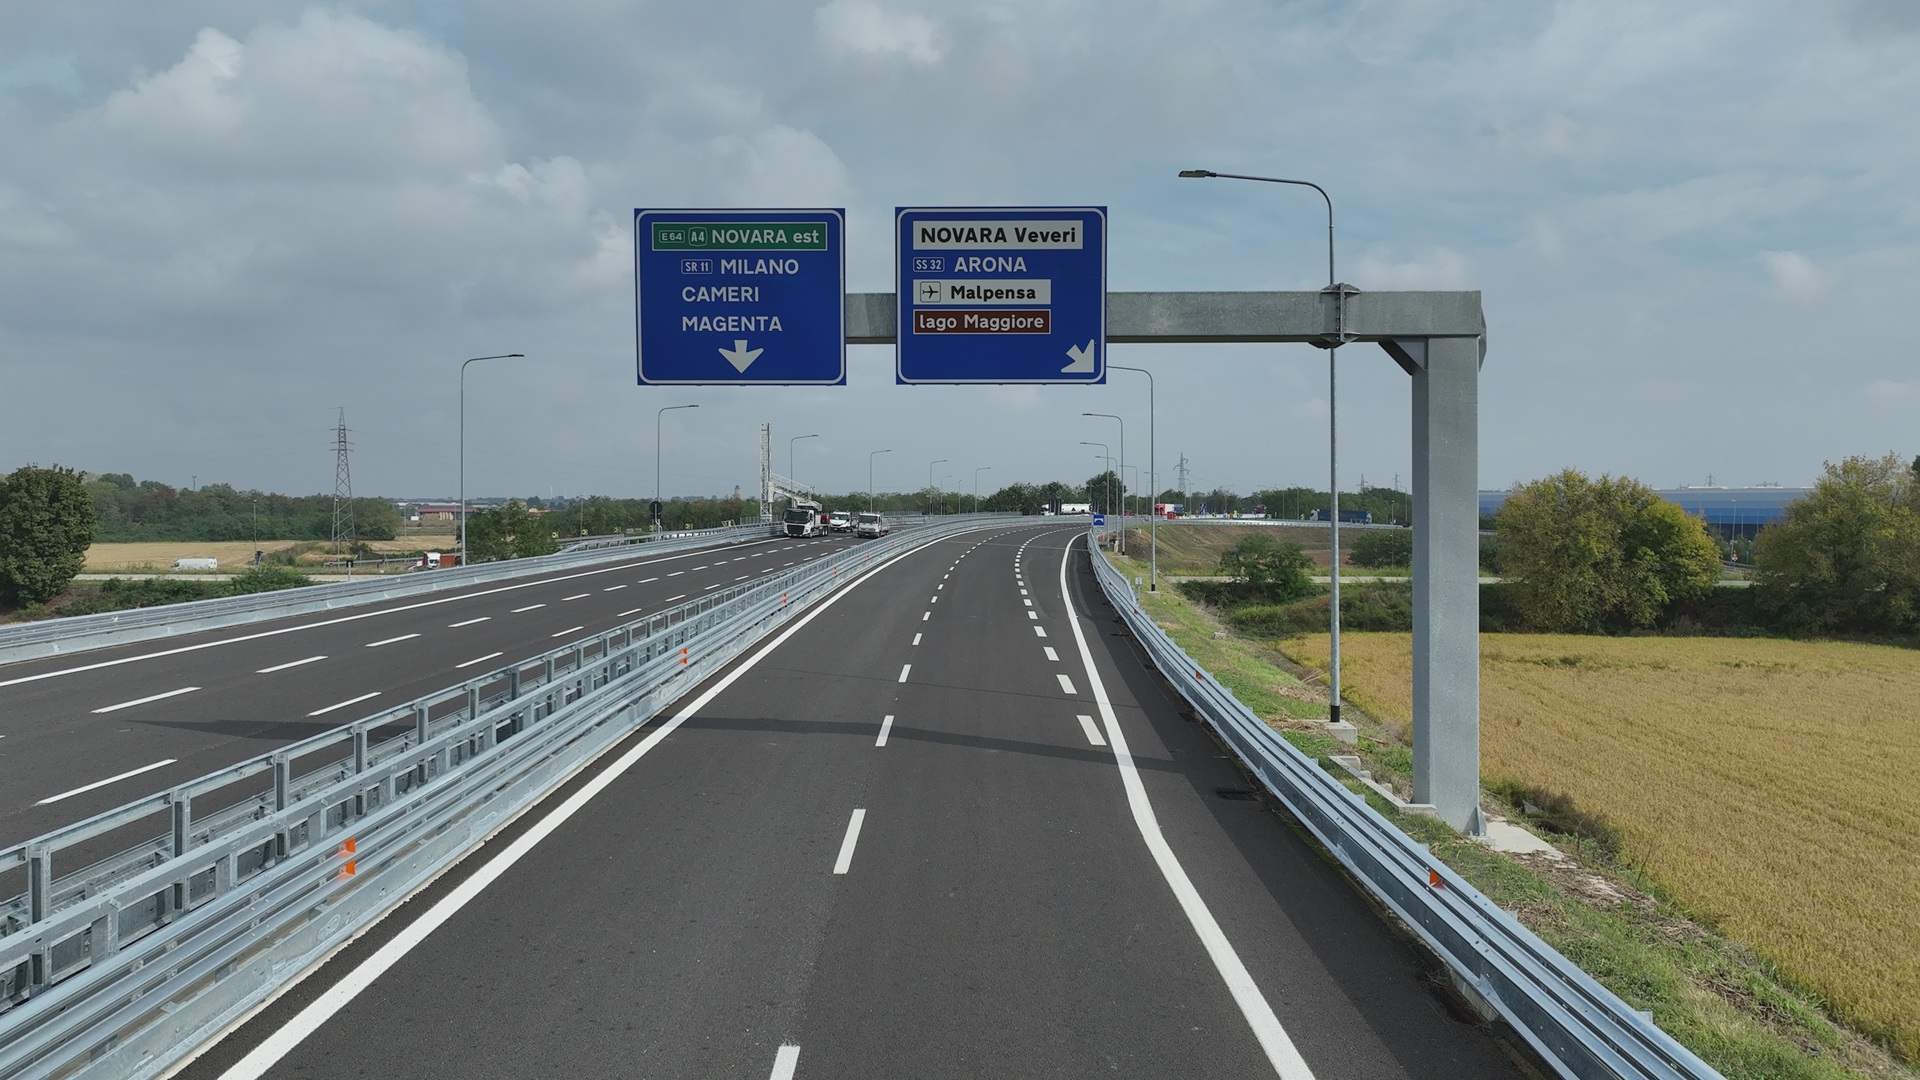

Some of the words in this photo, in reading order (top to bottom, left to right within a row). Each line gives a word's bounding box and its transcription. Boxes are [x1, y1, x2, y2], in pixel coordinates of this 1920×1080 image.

[691, 231, 705, 242] A4
[712, 229, 787, 244] NOVARA
[793, 229, 819, 244] est
[921, 227, 1007, 243] NOVARA
[1015, 227, 1076, 243] Veveri
[685, 262, 698, 272] SR
[700, 262, 709, 272] 11
[720, 259, 799, 275] MILANO
[916, 260, 928, 270] SS
[930, 260, 942, 270] 32
[954, 257, 1027, 273] ARONA
[681, 286, 759, 302] CAMERI
[950, 285, 1036, 302] Malpensa
[682, 316, 783, 332] MAGENTA
[919, 314, 957, 332] lago
[963, 314, 1044, 332] Maggiore
